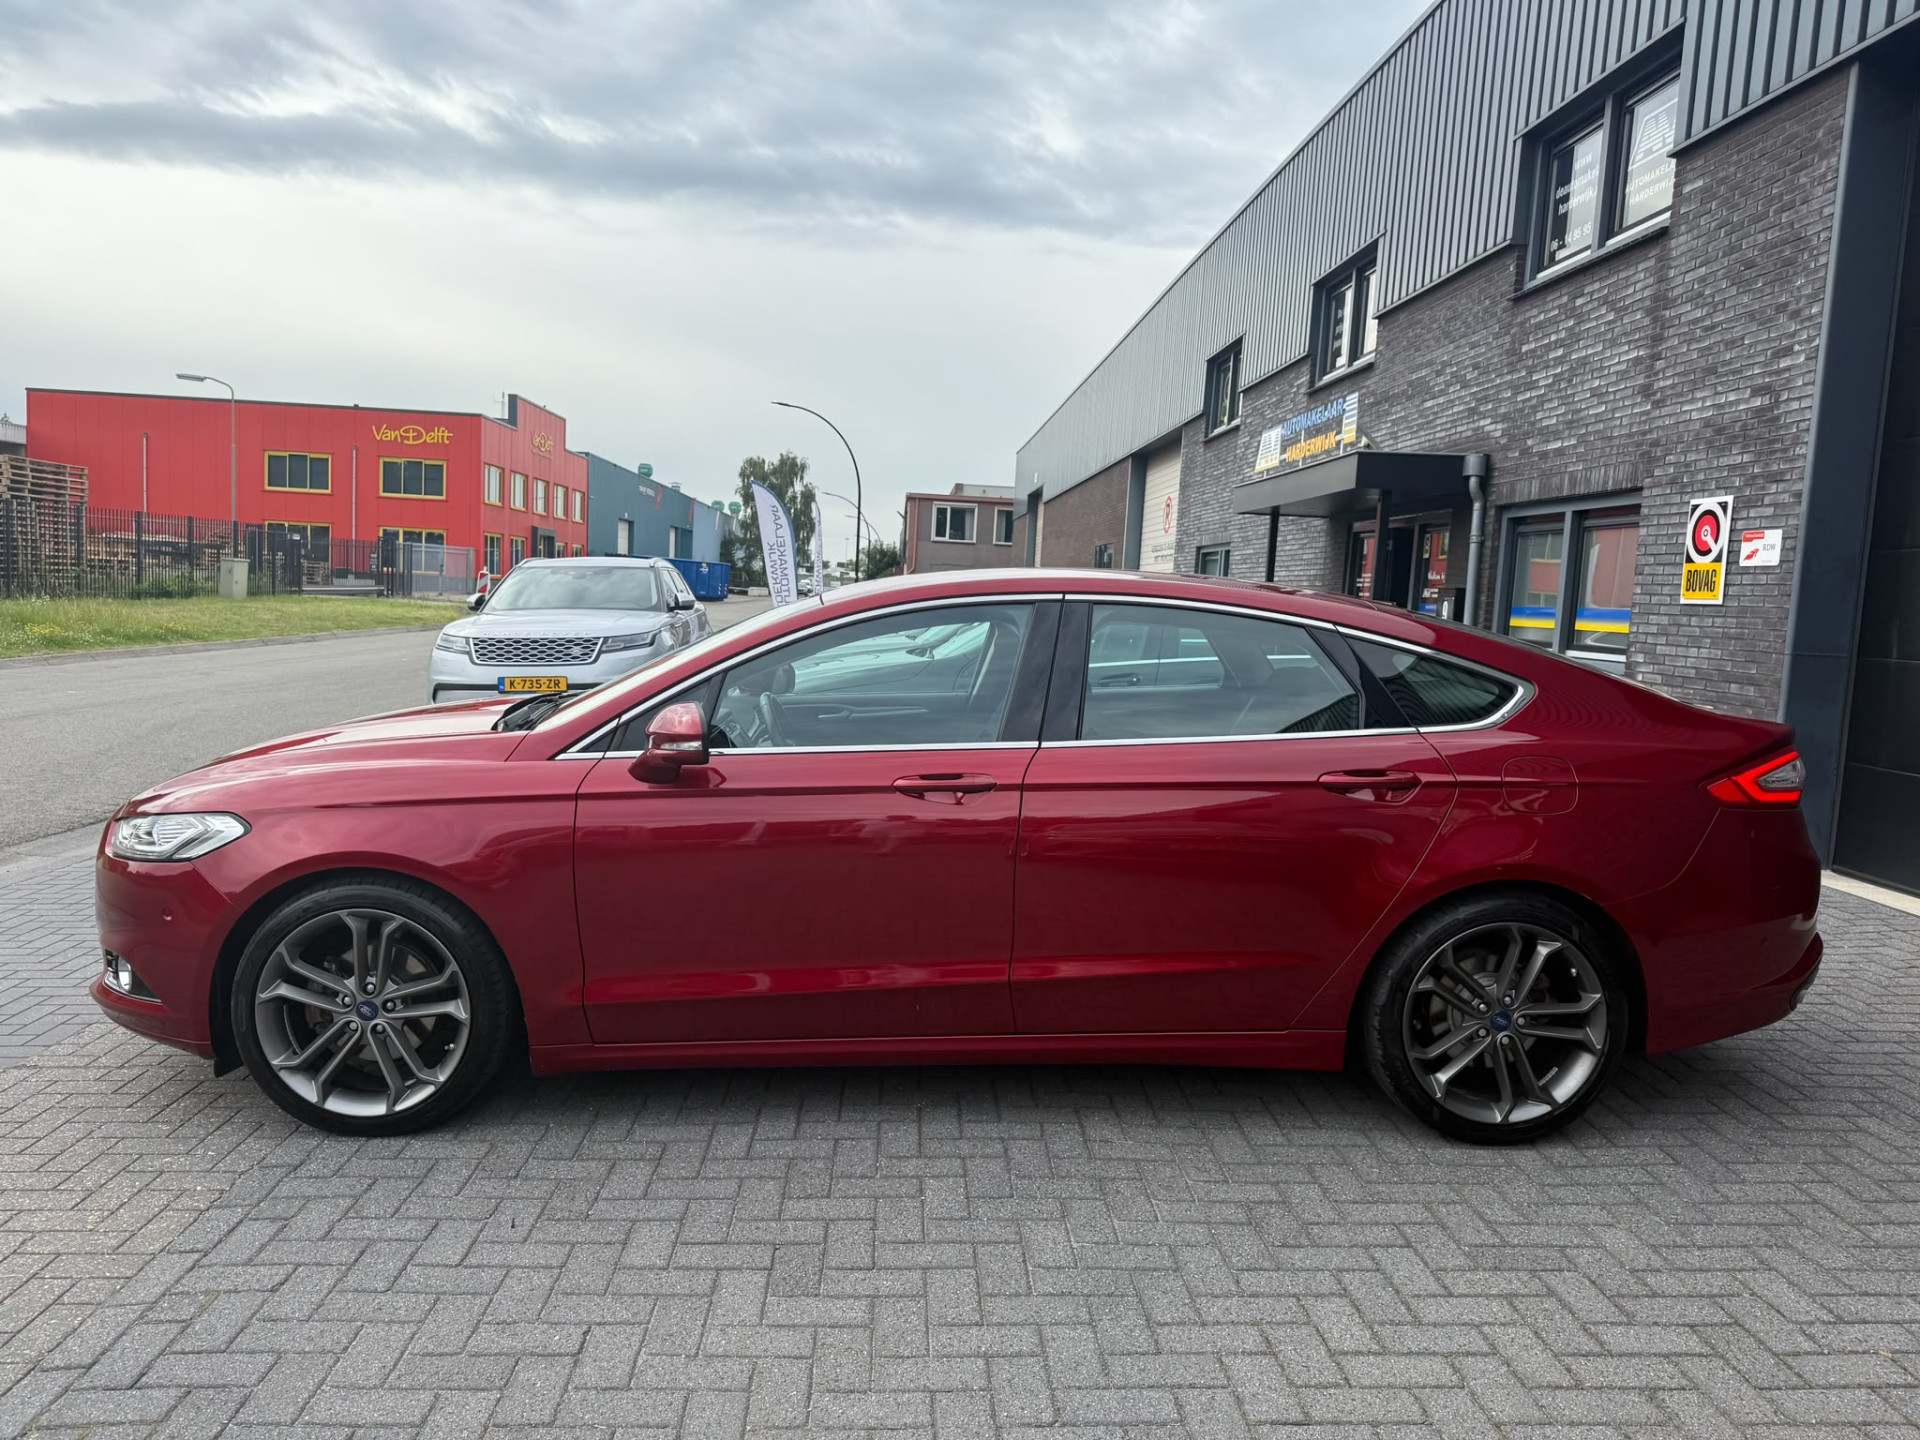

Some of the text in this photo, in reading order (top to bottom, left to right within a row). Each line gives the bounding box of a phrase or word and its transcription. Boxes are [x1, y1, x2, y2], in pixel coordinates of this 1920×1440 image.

[1625, 159, 1676, 193] AUTOMAKELA
[1281, 398, 1344, 437] AUTOMAKELAAR
[1286, 430, 1337, 463] HARDERWIJK
[1762, 543, 1777, 552] RDW
[1685, 568, 1717, 592] BOVAG
[1441, 600, 1449, 619] 9
[509, 679, 562, 690] K-735-ZR
